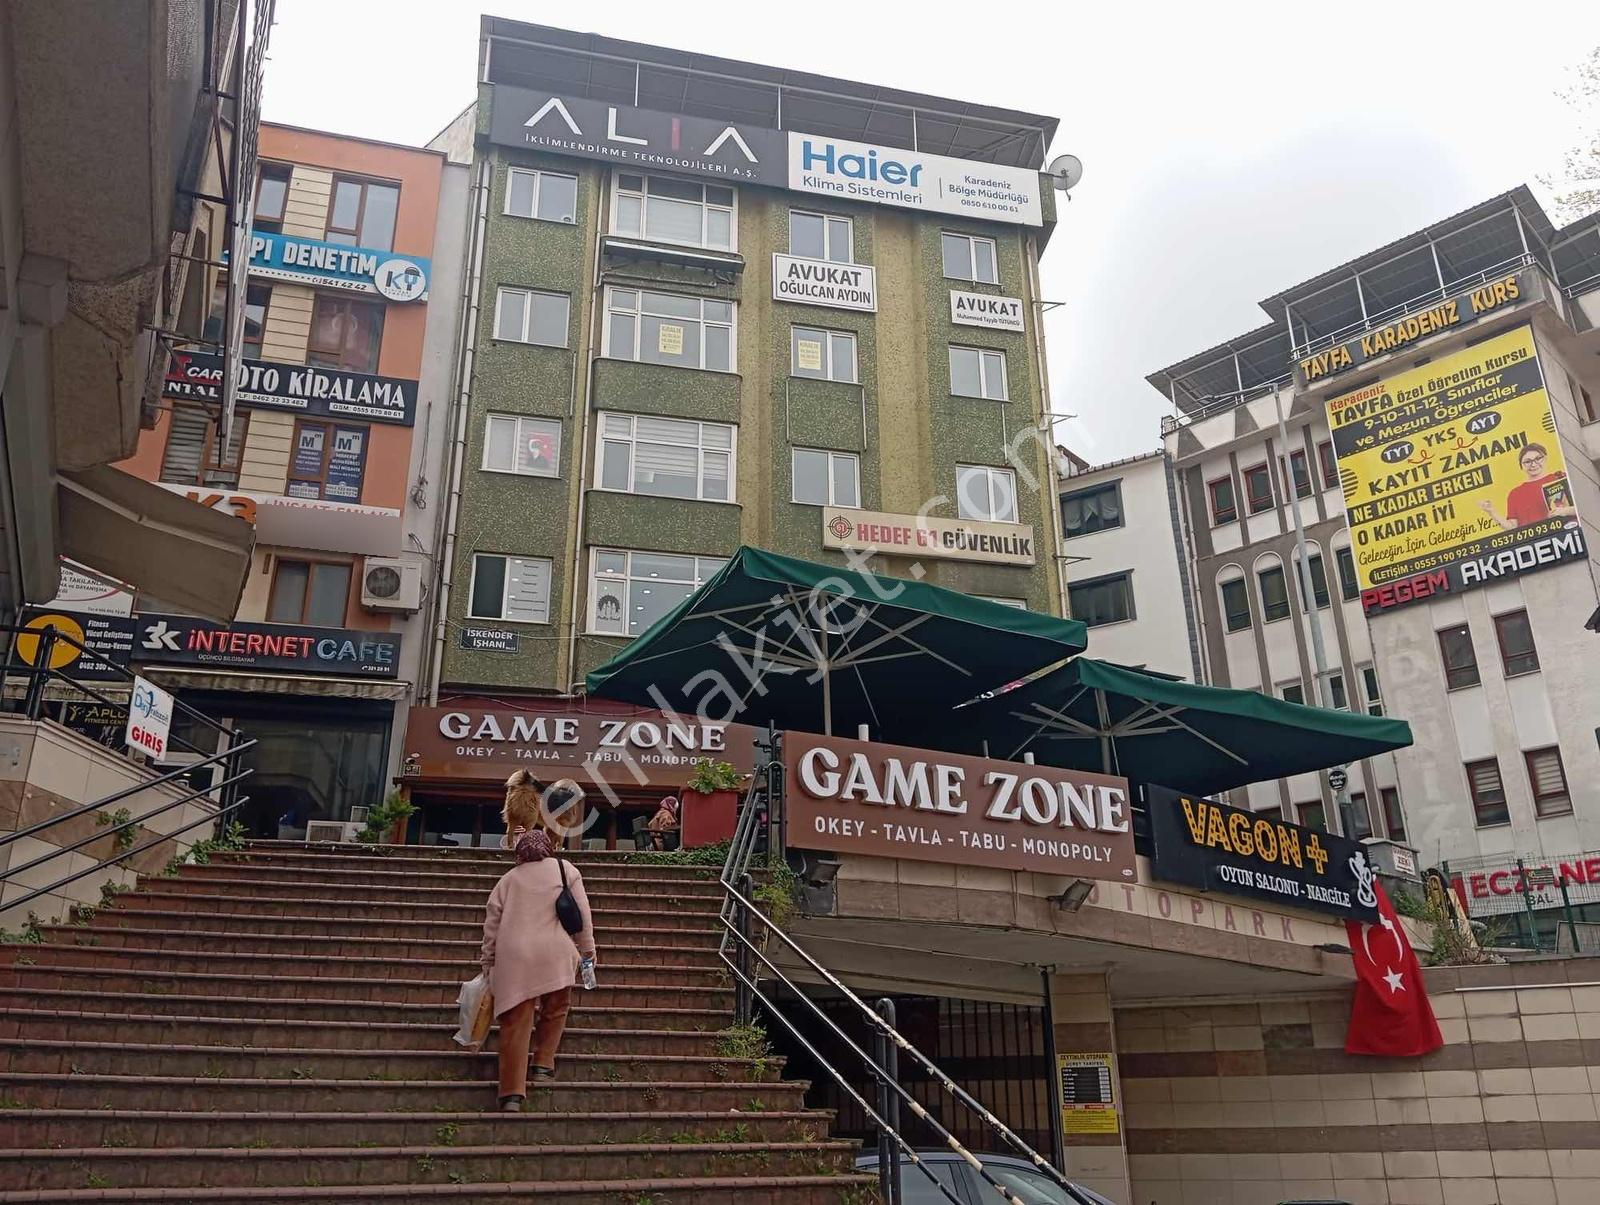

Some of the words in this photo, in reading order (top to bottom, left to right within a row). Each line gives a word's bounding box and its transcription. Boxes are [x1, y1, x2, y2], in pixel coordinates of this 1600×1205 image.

[524, 97, 759, 163] ALIA
[525, 133, 628, 158] İKLİMLENDİRME
[633, 151, 727, 173] TEKNOLOJİLERİ
[803, 140, 923, 188] Haier
[803, 175, 844, 192] Klima
[848, 182, 922, 205] Sistemleri
[949, 184, 976, 197] Bölge
[978, 189, 1029, 205] Müdürlüğü
[964, 175, 1012, 190] Karadeniz
[250, 236, 273, 262] PI
[779, 279, 835, 300] OĞULCAN
[837, 289, 871, 304] AYDIN
[787, 262, 862, 287] AVUKAT
[956, 296, 1019, 317] AVUKAT
[1301, 345, 1353, 381] TAYFA
[1361, 301, 1460, 358] KARADENİZ
[1470, 277, 1520, 315] KURS
[289, 369, 406, 409] KİRALAMA
[1330, 383, 1386, 412] Karadeniz
[1332, 394, 1394, 426] TAYFA
[1397, 385, 1424, 404] Özel
[1427, 364, 1481, 393] Öğretim
[1486, 347, 1528, 371] Kursu
[1447, 373, 1503, 401] Sınıflar
[1355, 436, 1376, 447] ve
[1378, 416, 1431, 440] Mezun
[1436, 382, 1518, 419] Öğrenciler
[1384, 444, 1412, 461] TYT
[1423, 427, 1457, 448] YKS
[1469, 413, 1498, 433] AYT
[1368, 461, 1433, 496] KAYIT
[1440, 431, 1528, 474] ZAMANI
[1353, 506, 1374, 524] NE
[1376, 488, 1427, 520] KADAR
[1430, 468, 1485, 503] ERKEN
[856, 523, 912, 546] HEDEF
[916, 528, 938, 548] 61
[942, 528, 1033, 556] GÜVENLİK
[1357, 529, 1369, 546] O
[1374, 512, 1428, 543] KADAR
[1432, 500, 1456, 525] İYİ
[1358, 543, 1405, 566] Geleceğin
[1428, 522, 1477, 546] Geleceğin
[1414, 559, 1437, 570] 0555
[1438, 553, 1455, 564] 190
[1456, 550, 1468, 560] 92
[1469, 545, 1482, 556] 32
[1491, 536, 1515, 549] 0537
[1536, 525, 1548, 537] 93
[1550, 520, 1562, 530] 40
[1364, 570, 1450, 610] PEGEM
[1460, 532, 1584, 586] AKADEMİ
[88, 619, 110, 629] Fitness
[467, 628, 513, 640] İSKENDER
[473, 637, 506, 649] İŞHANI
[317, 638, 393, 664] CAFE
[86, 706, 129, 719] APLU
[439, 712, 580, 745] GAME
[599, 720, 727, 751] ZONE
[131, 725, 164, 757] GİRİŞ
[456, 746, 494, 757] OKEY
[515, 748, 561, 760] TAVLA
[585, 752, 623, 763] TABU
[641, 755, 715, 767] MONOPOY
[799, 747, 968, 814] GAME
[983, 772, 1129, 833] ZONE
[814, 815, 866, 838] OKEY
[883, 823, 943, 846] TAVLA
[959, 830, 1006, 851] TABU
[1022, 838, 1112, 863] MONOPOLY
[1220, 864, 1254, 888] OYUN
[1256, 872, 1300, 897] SALONU
[1306, 884, 1352, 908] NARGİLE
[1470, 857, 1600, 899] ECZNE
